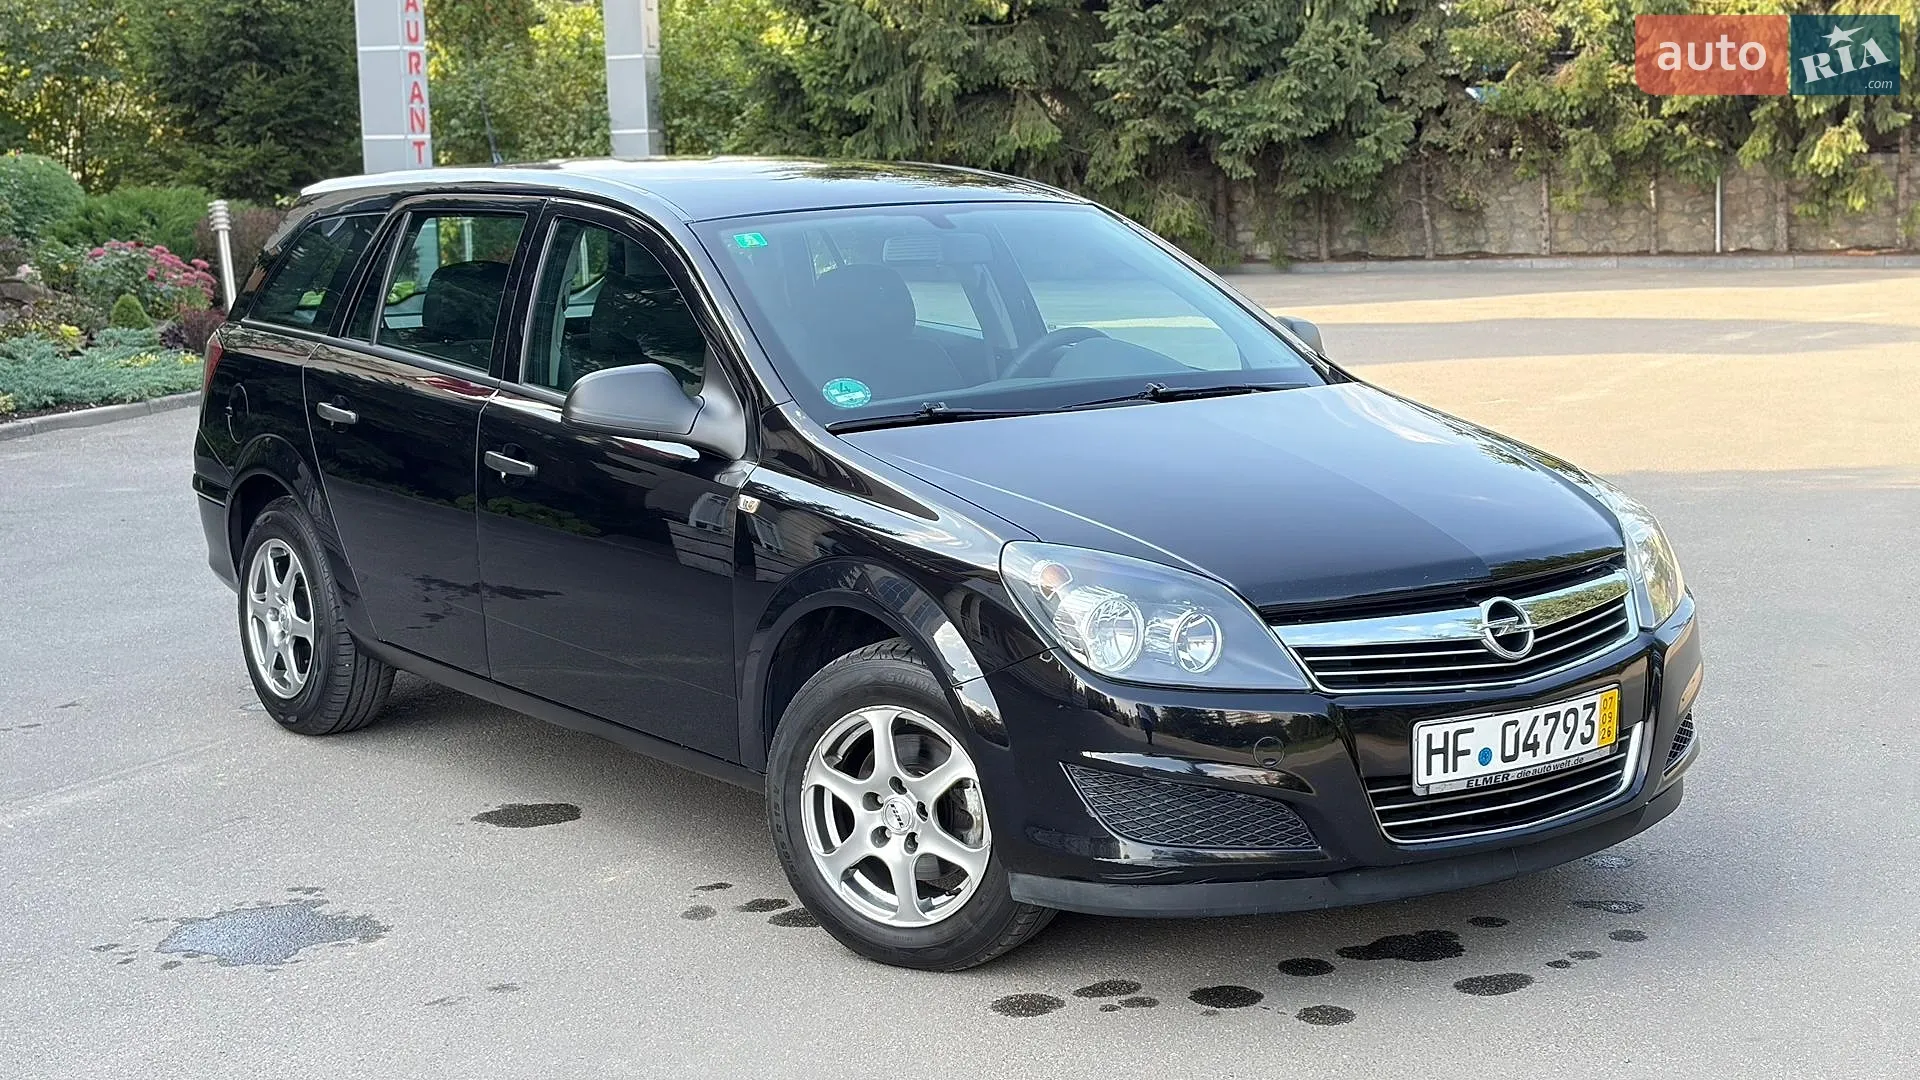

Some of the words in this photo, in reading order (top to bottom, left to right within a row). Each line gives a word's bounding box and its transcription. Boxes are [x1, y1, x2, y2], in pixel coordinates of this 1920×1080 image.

[1602, 696, 1614, 710] 07
[1601, 711, 1613, 725] 09
[1426, 726, 1475, 776] HF
[1500, 702, 1597, 764] 04793
[1601, 725, 1612, 740] 26
[1466, 772, 1511, 788] ELMER
